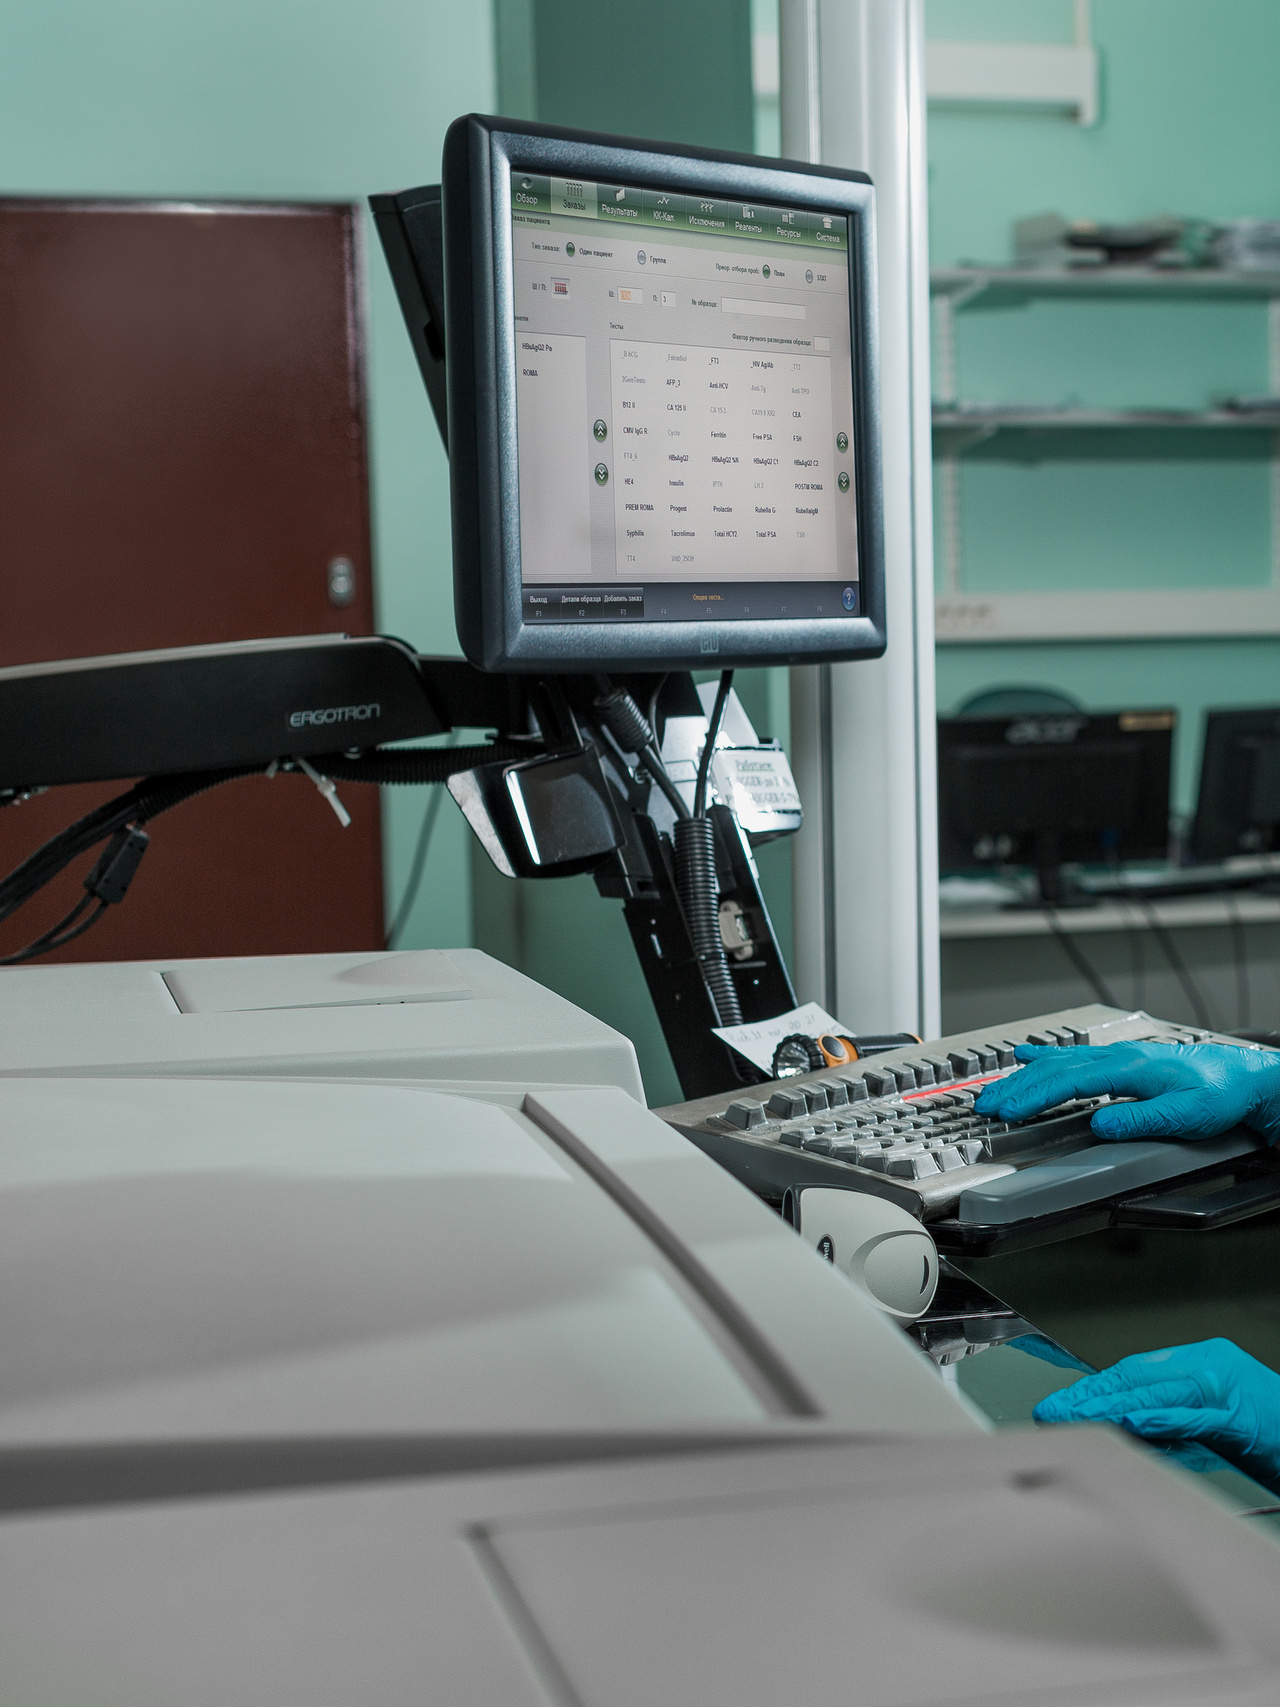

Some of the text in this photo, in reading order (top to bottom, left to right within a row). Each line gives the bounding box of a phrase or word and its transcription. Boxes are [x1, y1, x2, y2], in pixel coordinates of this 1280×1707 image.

[516, 193, 538, 206] Обзор
[563, 199, 586, 211] Заказы
[602, 204, 639, 218] Результаты
[689, 216, 726, 229] Исключения
[735, 222, 762, 233] Реагенты
[776, 227, 801, 239] Ресурсы
[816, 232, 841, 244] Система
[531, 242, 541, 250] Тип
[580, 248, 614, 258] Один пациент
[650, 255, 667, 265] Группа
[774, 270, 785, 278] План
[609, 322, 624, 330] Тесты
[732, 333, 748, 342] Фактор
[709, 357, 719, 365] _FT3
[750, 360, 760, 369] _HIV
[523, 369, 539, 377] ROMA
[666, 379, 681, 388] AFP_3
[622, 400, 632, 409] B12
[667, 403, 674, 411] CA
[710, 406, 717, 414] CA
[792, 411, 801, 419] CEA
[623, 427, 634, 435] CMV
[635, 427, 643, 436] IgG
[668, 429, 681, 437] Cyclo
[710, 431, 727, 439] Ferritin
[763, 433, 773, 441] PSA
[669, 479, 684, 487] Insulin
[625, 503, 639, 511] PREM
[670, 504, 687, 513] Progest
[713, 505, 733, 513] Prolactin
[755, 506, 776, 514] Rubella G
[626, 529, 645, 538] Syphilis
[714, 530, 725, 538] Total
[756, 530, 767, 538] Total
[530, 595, 547, 604] Выход
[561, 595, 602, 604] Детали образца
[603, 594, 627, 603] Добавить
[579, 609, 586, 617] F2
[289, 702, 382, 728] ERGOTRON
